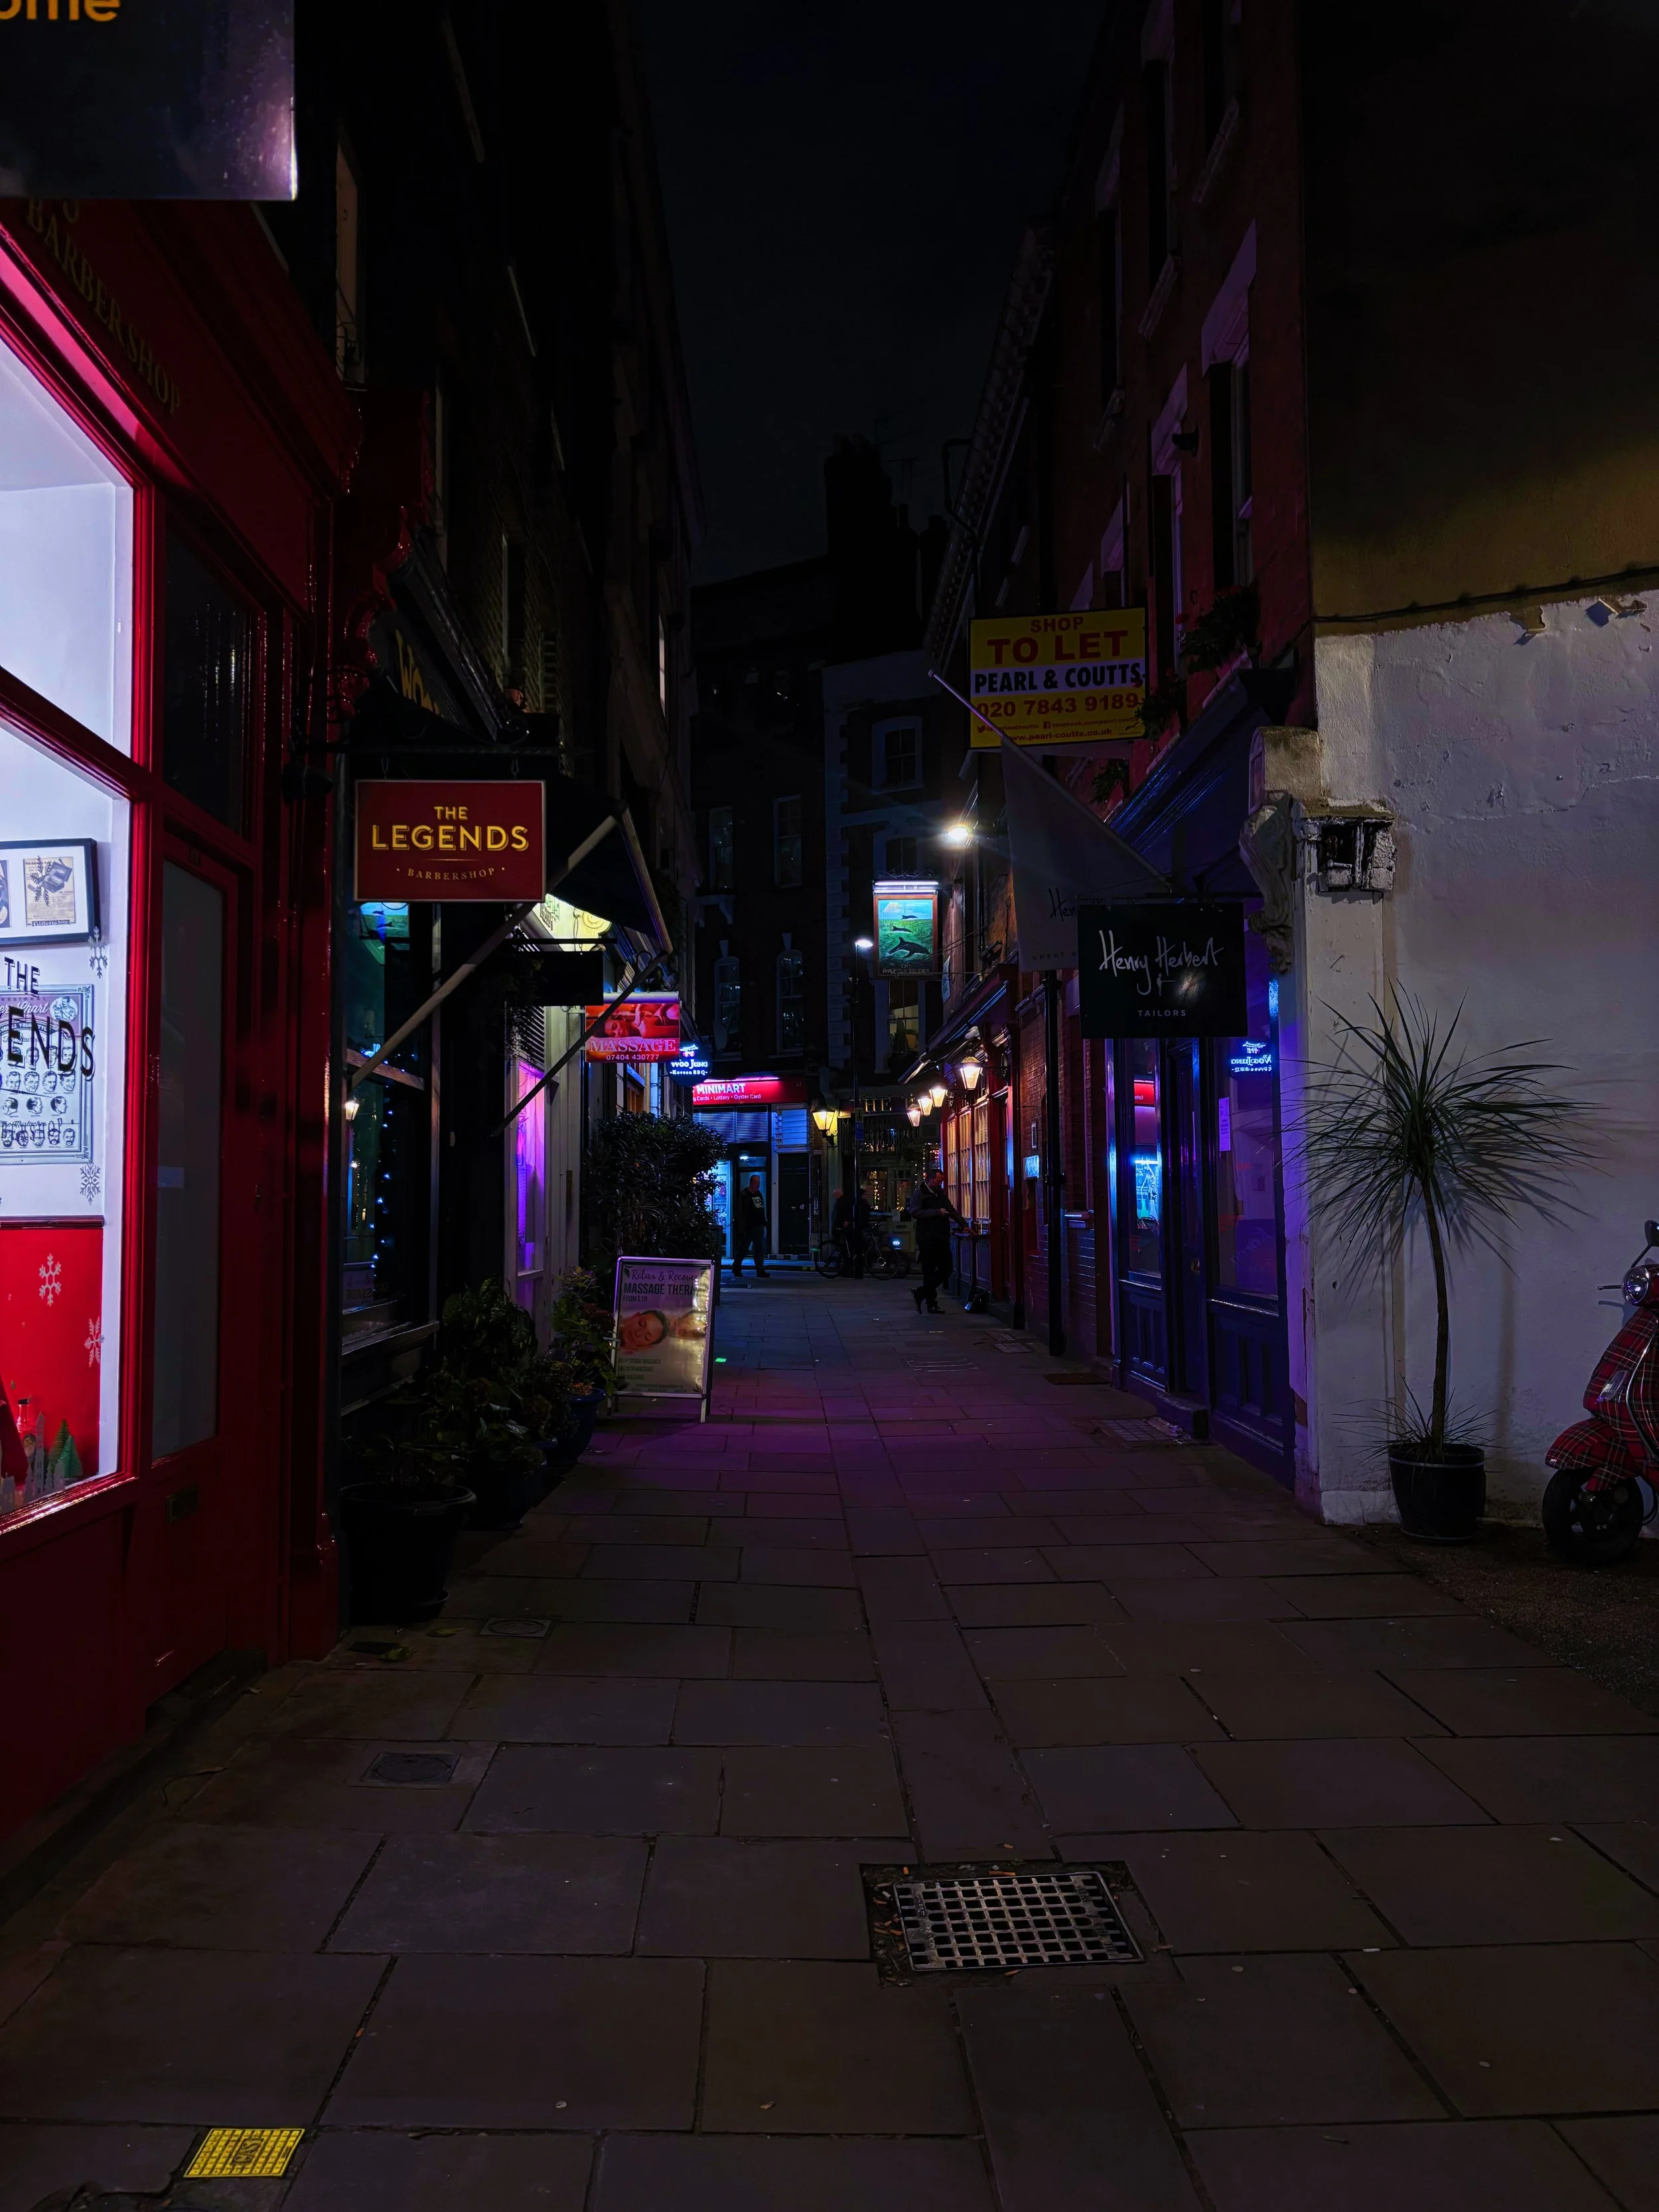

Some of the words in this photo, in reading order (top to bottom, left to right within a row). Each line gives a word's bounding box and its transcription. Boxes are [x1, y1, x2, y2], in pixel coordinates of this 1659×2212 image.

[1030, 616, 1084, 633] SHOP
[987, 636, 1039, 664] TO
[1054, 630, 1128, 661] LET
[974, 670, 1037, 694] PEARL
[1043, 669, 1058, 690] &
[1064, 662, 1141, 688] COUTTS
[977, 701, 1016, 717] 020
[1023, 697, 1076, 716] 7843
[1084, 692, 1139, 712] 9189
[433, 806, 469, 821] THE
[372, 824, 530, 852] LEGENDS
[407, 867, 495, 881] BARBERSHOP
[1098, 929, 1152, 995] Henry
[4, 956, 40, 996] THE
[1137, 1009, 1187, 1017] TAILORS
[589, 1039, 676, 1053] MASSAGE
[695, 1082, 746, 1095] MINIMART
[631, 1268, 657, 1281] Relax
[624, 1282, 665, 1295] MASSAGE
